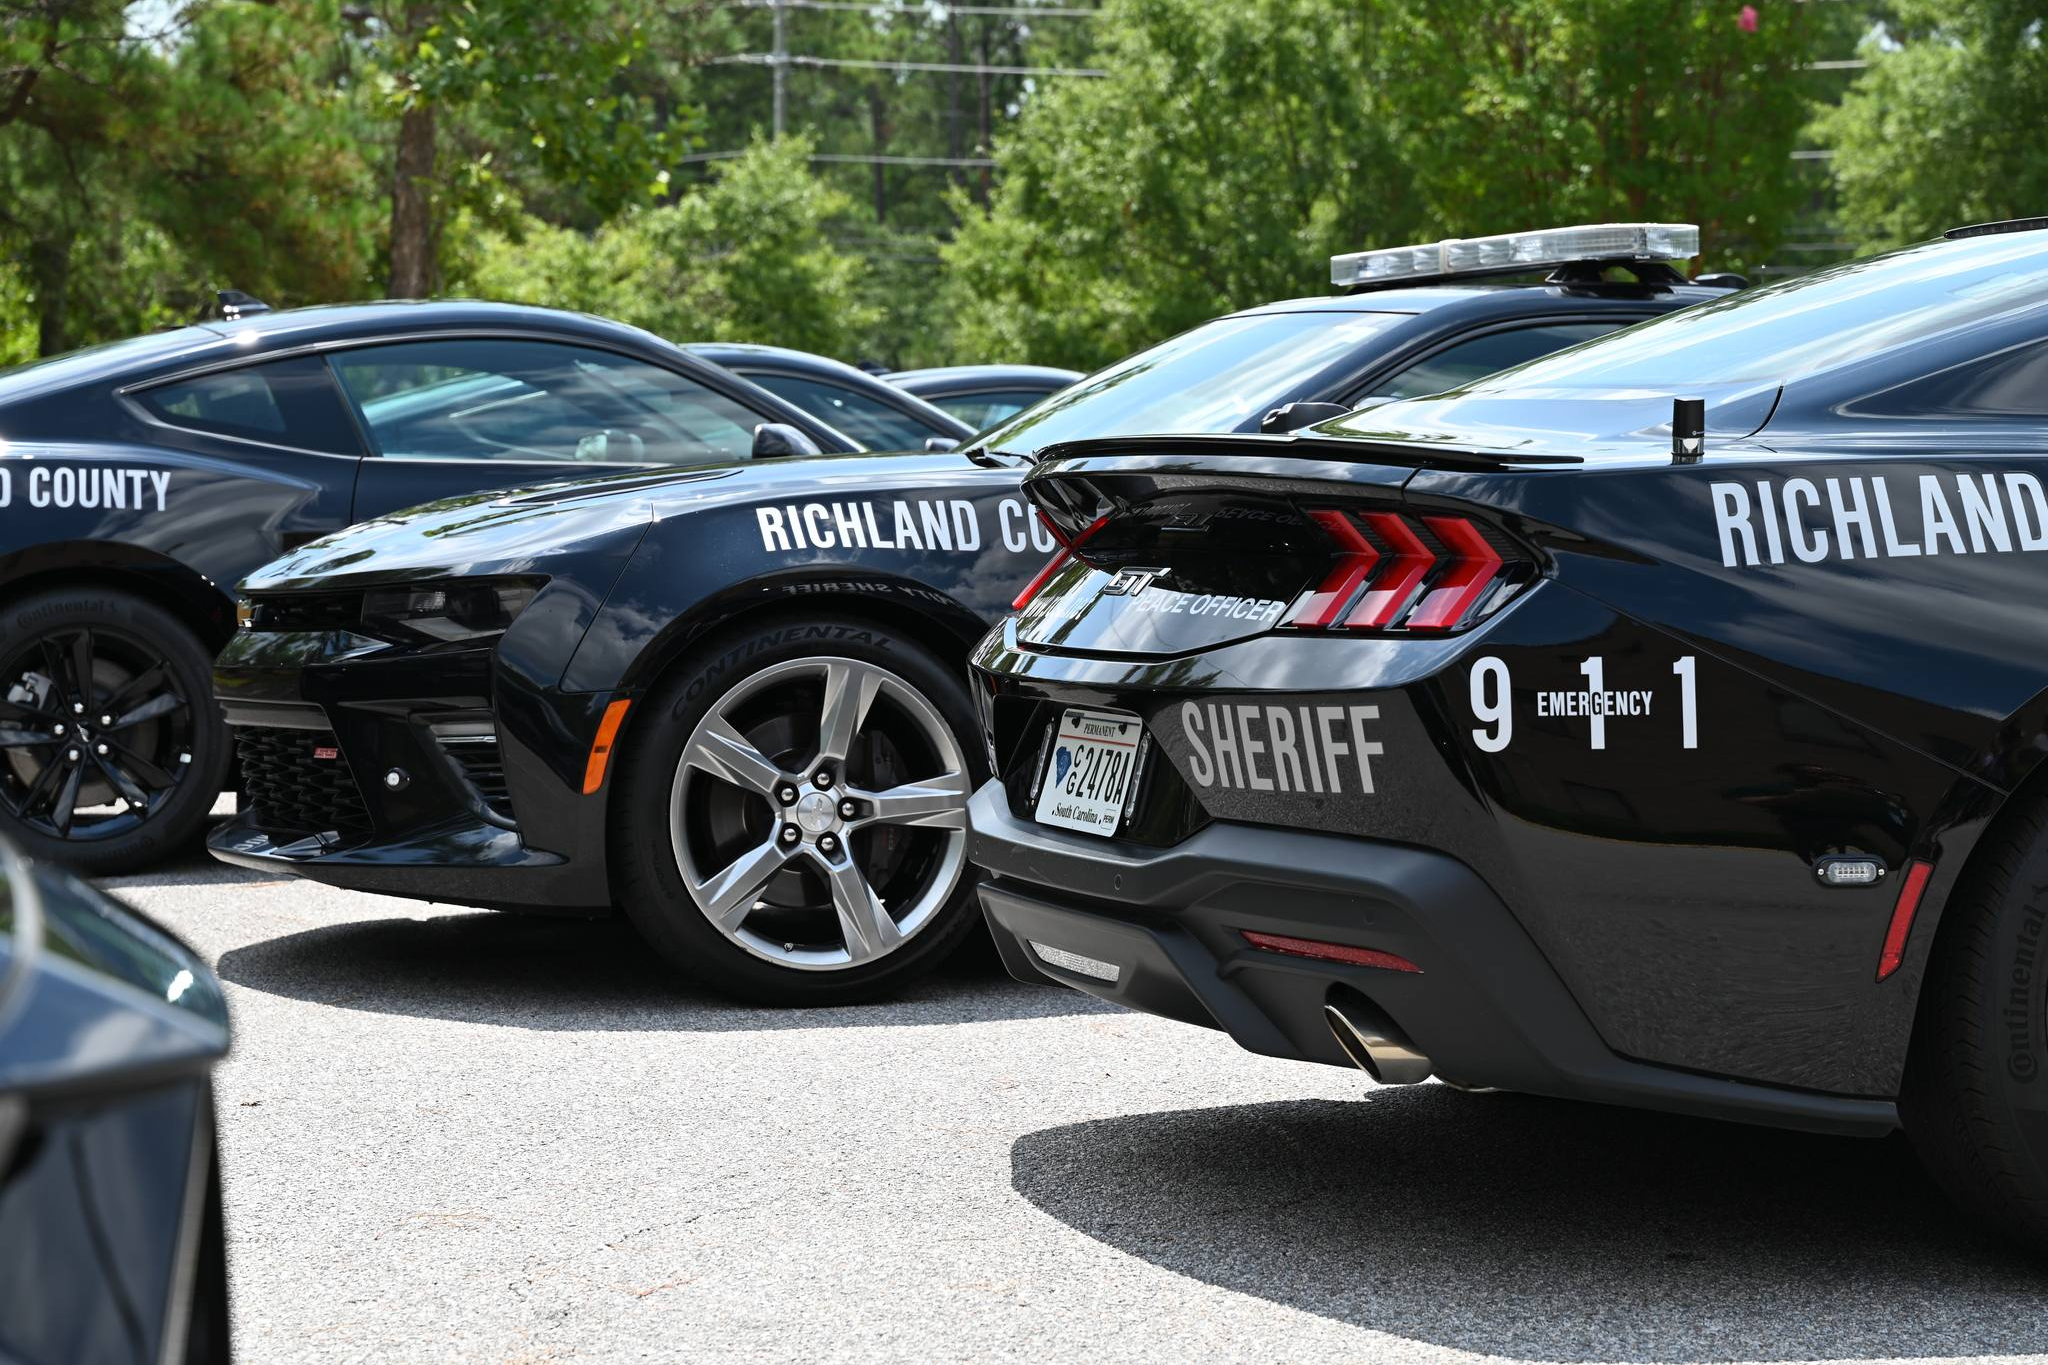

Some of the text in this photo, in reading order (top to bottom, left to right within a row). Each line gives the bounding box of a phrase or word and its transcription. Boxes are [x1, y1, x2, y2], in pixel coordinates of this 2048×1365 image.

[29, 466, 171, 512] COUNTY
[756, 499, 981, 552] RICHLAND
[1710, 473, 2048, 568] RICHLAND
[1103, 566, 1172, 597] GT
[1125, 592, 1195, 613] PEACE
[1189, 594, 1287, 622] OFFICER
[671, 625, 893, 721] CONTINENTAL
[1469, 656, 1513, 753] 9
[1673, 655, 1698, 749] 1
[1537, 690, 1653, 717] EMERGENCY
[1083, 723, 1117, 738] PERMANENT
[1181, 701, 1384, 794] SHERIFF
[1054, 802, 1099, 824] South Carolina
